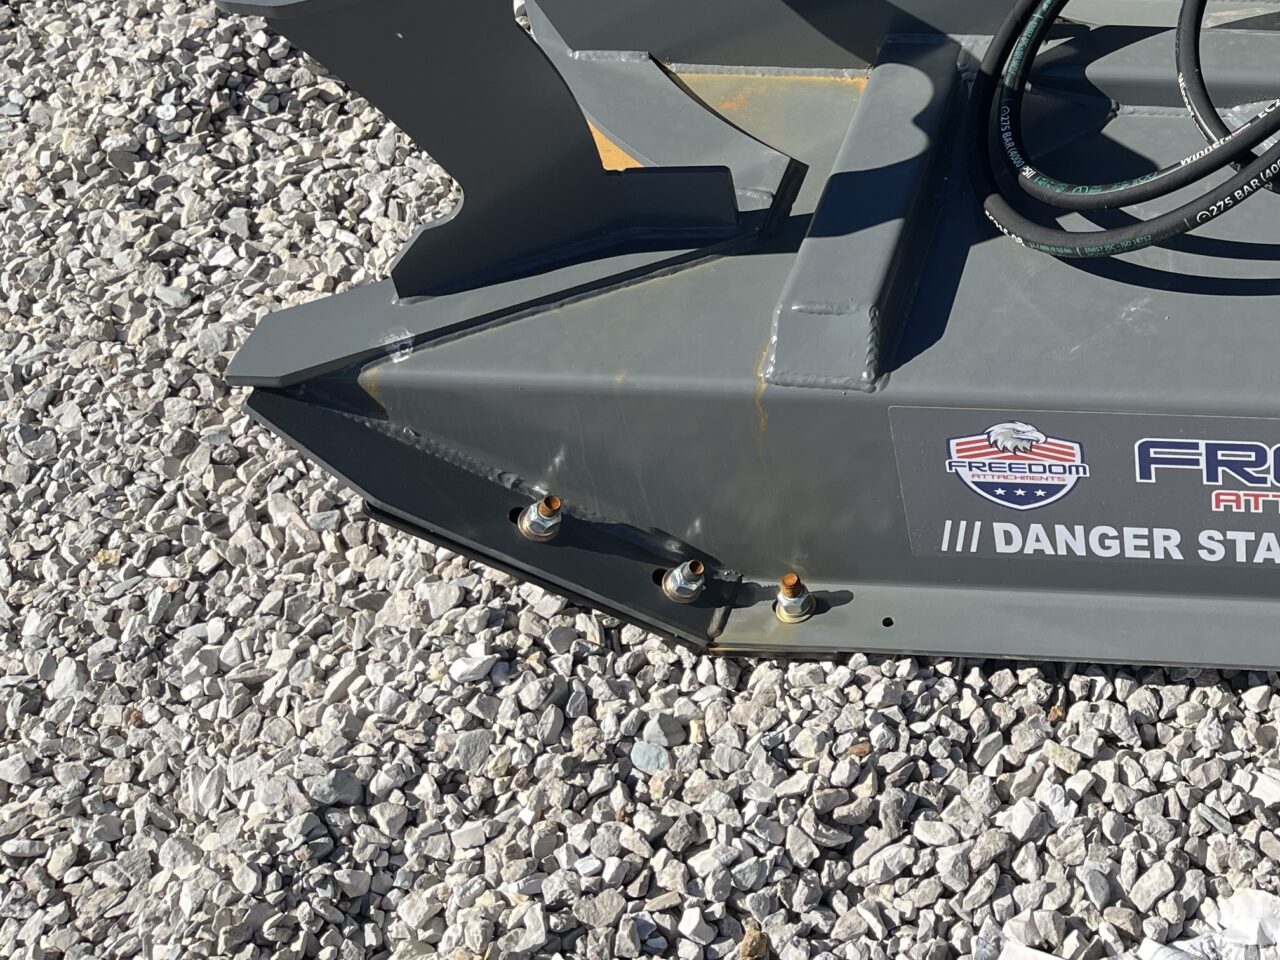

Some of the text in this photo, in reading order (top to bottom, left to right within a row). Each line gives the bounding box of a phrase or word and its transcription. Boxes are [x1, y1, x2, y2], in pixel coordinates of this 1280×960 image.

[1002, 131, 1015, 150] BAR
[1208, 198, 1234, 216] 275
[1234, 178, 1261, 201] BAR
[948, 460, 1088, 476] FREEDOM
[971, 473, 1066, 482] ATTACHMENTS
[992, 521, 1184, 560] DANGER
